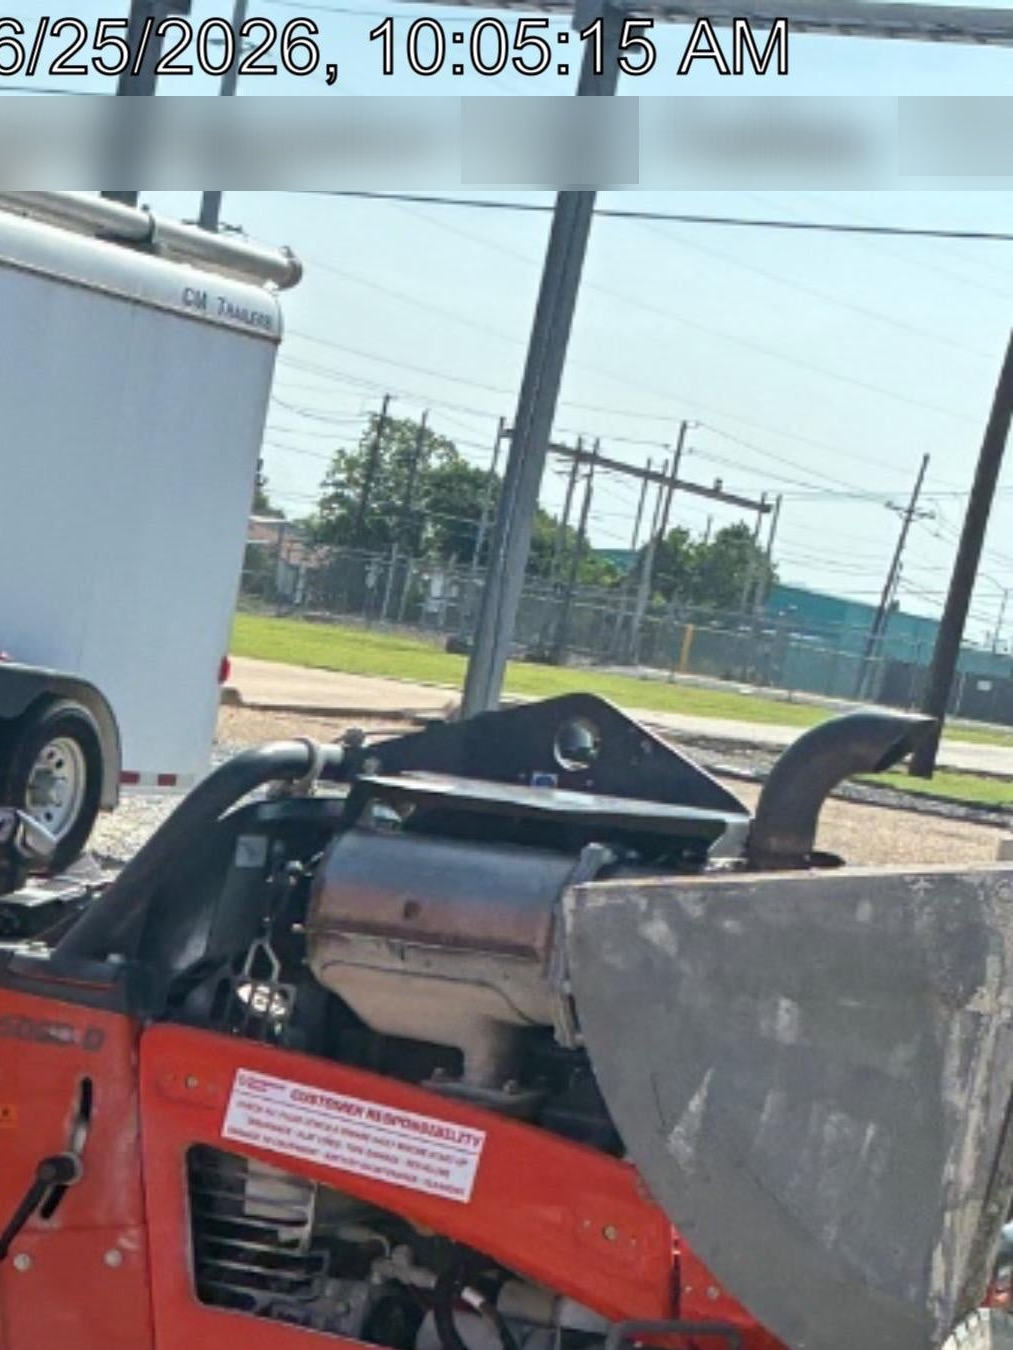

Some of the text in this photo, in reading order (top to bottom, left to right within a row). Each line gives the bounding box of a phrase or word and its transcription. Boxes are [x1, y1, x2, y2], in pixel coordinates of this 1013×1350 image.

[182, 287, 207, 310] CM
[289, 1088, 363, 1118] CUSTOMER
[366, 1107, 481, 1148] RESPONSIBILITY
